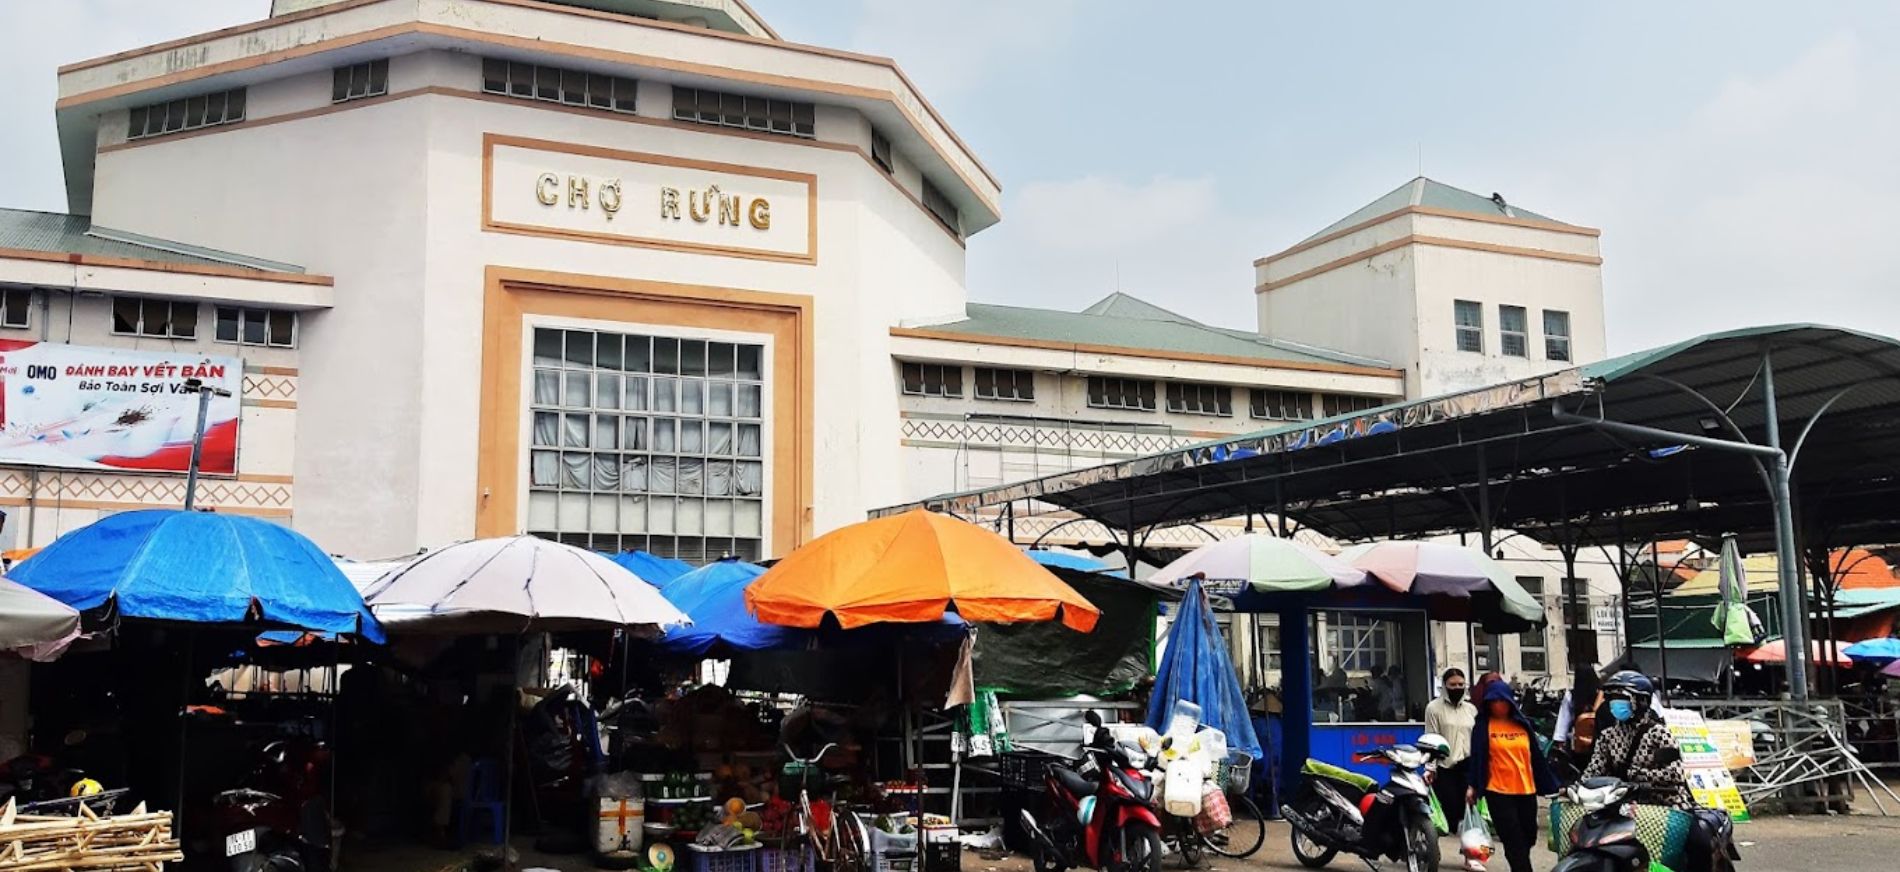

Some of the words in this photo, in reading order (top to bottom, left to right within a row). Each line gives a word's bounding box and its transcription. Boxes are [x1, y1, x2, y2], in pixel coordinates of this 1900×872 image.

[536, 172, 622, 220] CHỢ
[27, 364, 57, 380] OMO
[65, 363, 105, 377] ĐÁNH
[107, 365, 138, 377] BAY
[143, 361, 177, 378] VẾT
[140, 382, 164, 395] Sợi
